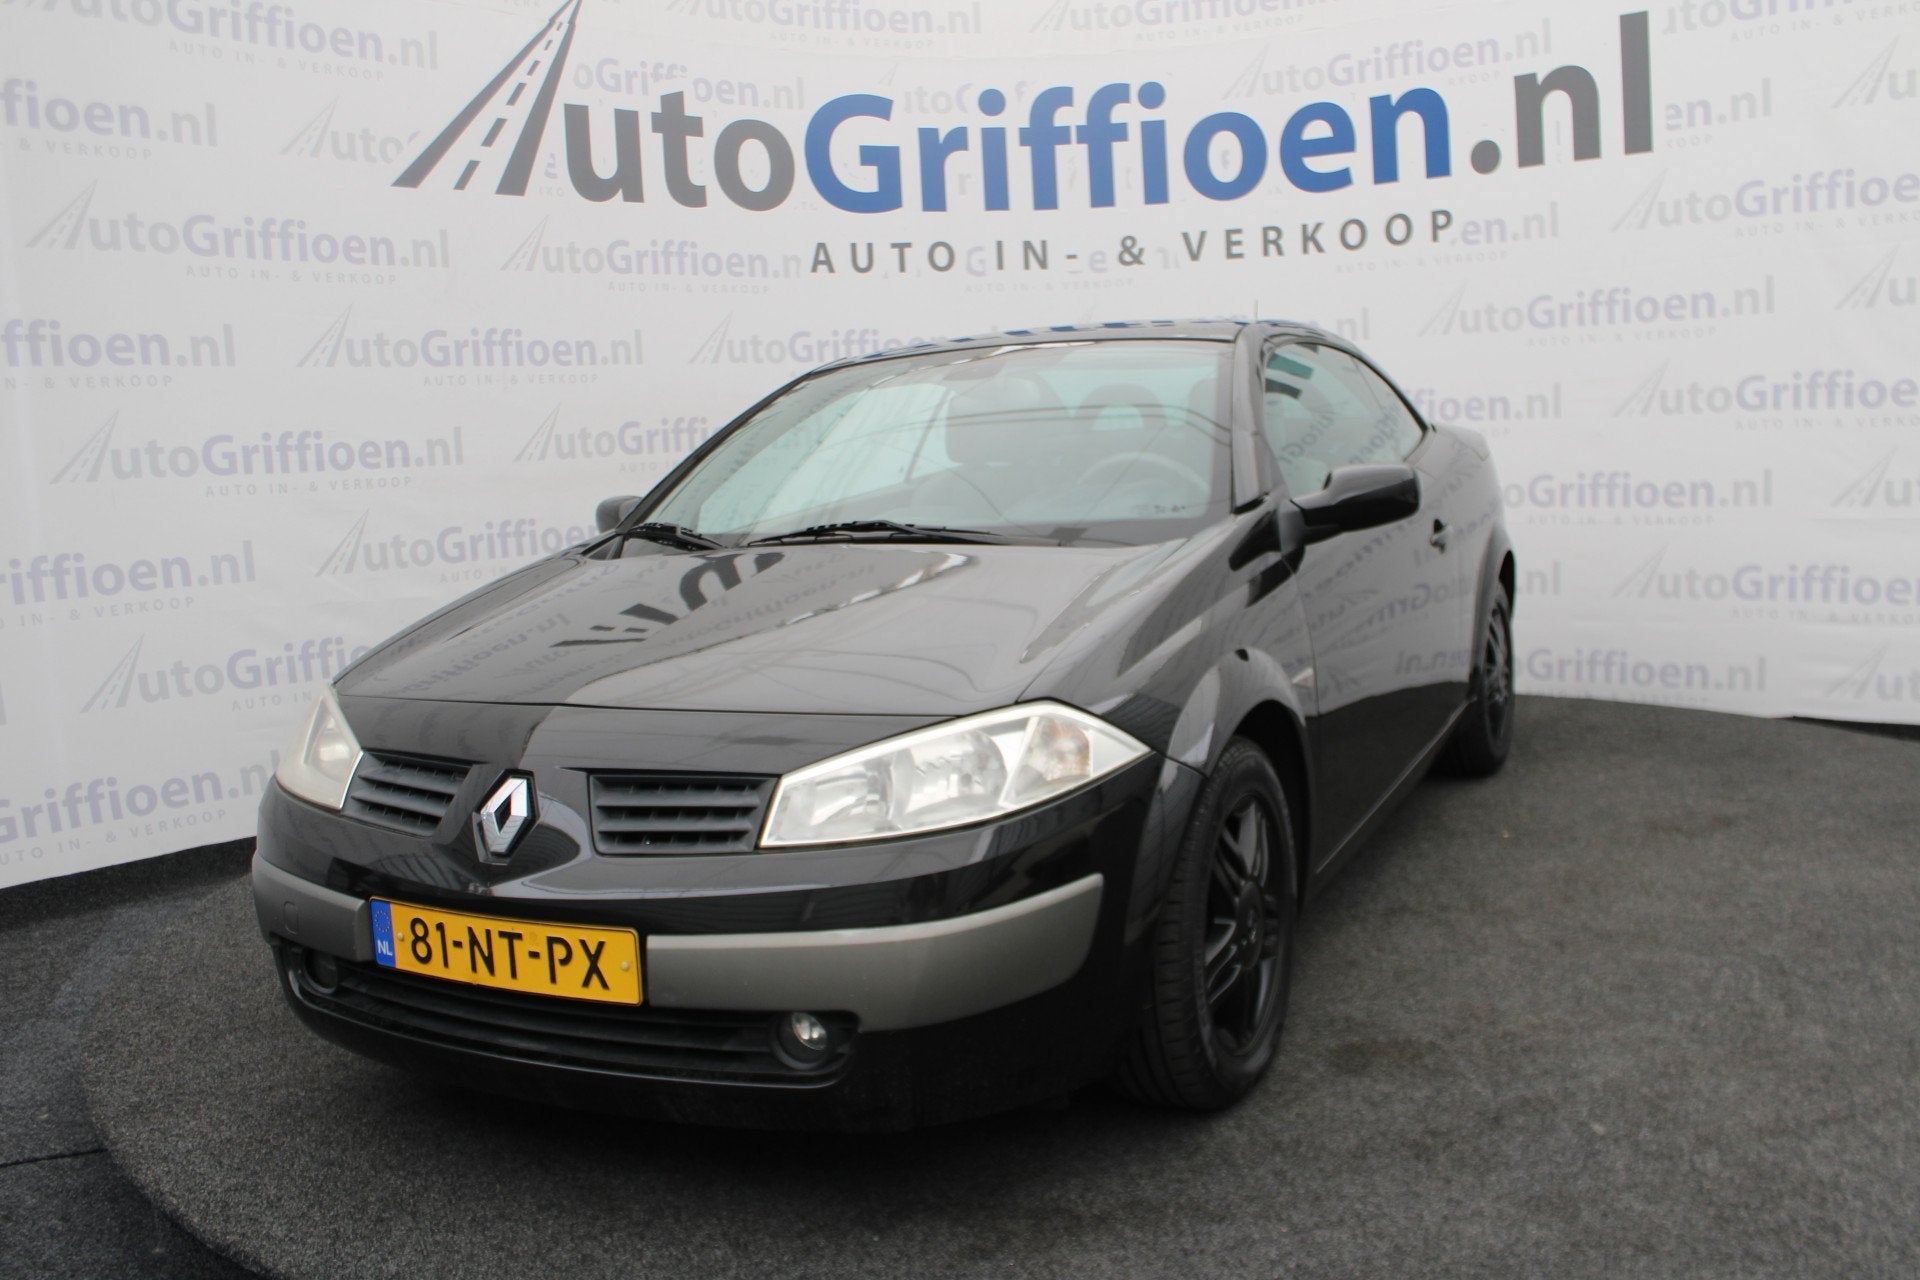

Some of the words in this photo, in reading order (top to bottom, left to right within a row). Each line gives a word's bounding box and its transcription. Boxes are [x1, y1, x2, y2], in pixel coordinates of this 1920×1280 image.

[24, 0, 439, 70] utoGriffioen.nl
[665, 0, 982, 34] utoGriffioen.nl
[391, 0, 1653, 214] AutoGriffioen.nl
[25, 177, 450, 268] AutoGriffioen.nl
[811, 240, 956, 273] AUTO
[996, 238, 1078, 271] IN-
[1118, 235, 1146, 267] &
[1183, 209, 1454, 262] VERKOOP
[296, 301, 643, 368] AutoGriffioen.nl
[1418, 274, 1775, 338] AutoGriffioen.nl
[49, 409, 464, 485] AutoGriffioen.nl
[0, 541, 257, 606] iffioen.nl
[94, 596, 195, 619] VERKOOP
[130, 809, 226, 839] VERKOOP
[377, 938, 393, 956] NL
[410, 917, 610, 991] 81-NT-PX
